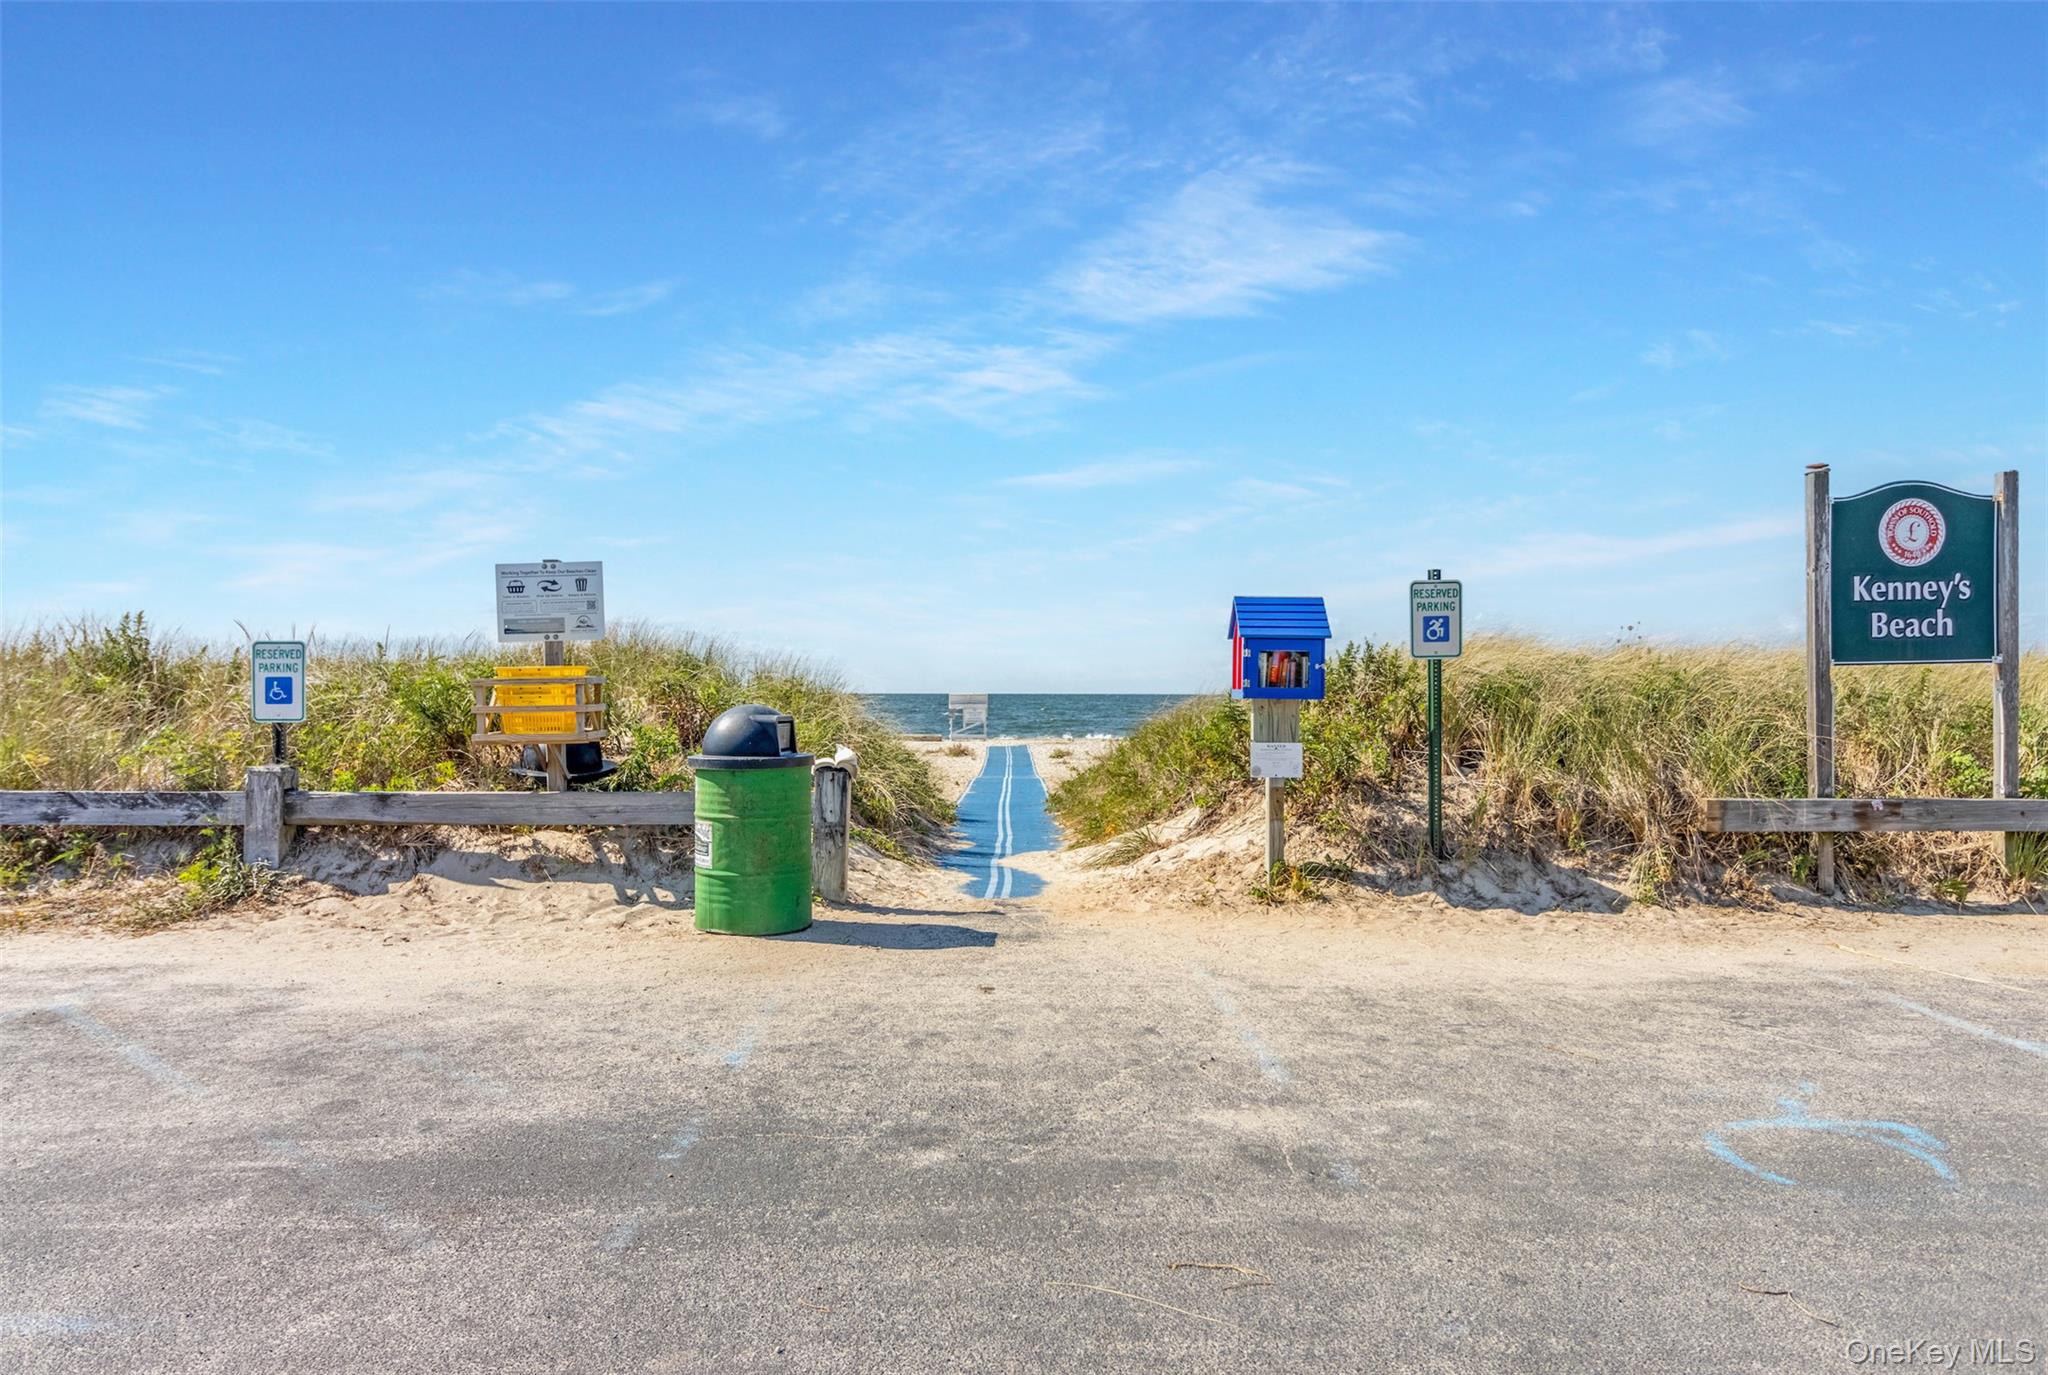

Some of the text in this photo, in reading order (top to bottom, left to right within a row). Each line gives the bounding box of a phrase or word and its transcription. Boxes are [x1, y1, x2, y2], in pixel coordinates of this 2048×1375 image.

[1898, 507, 1907, 517] OF
[1908, 507, 1937, 537] SOUTHOLD
[1413, 588, 1459, 599] RESERVED
[1853, 572, 1971, 609] Kenney's
[1416, 602, 1456, 612] PARKING
[1871, 609, 1953, 638] Beach
[255, 648, 302, 659] RESERVED
[258, 663, 299, 673] PARKING
